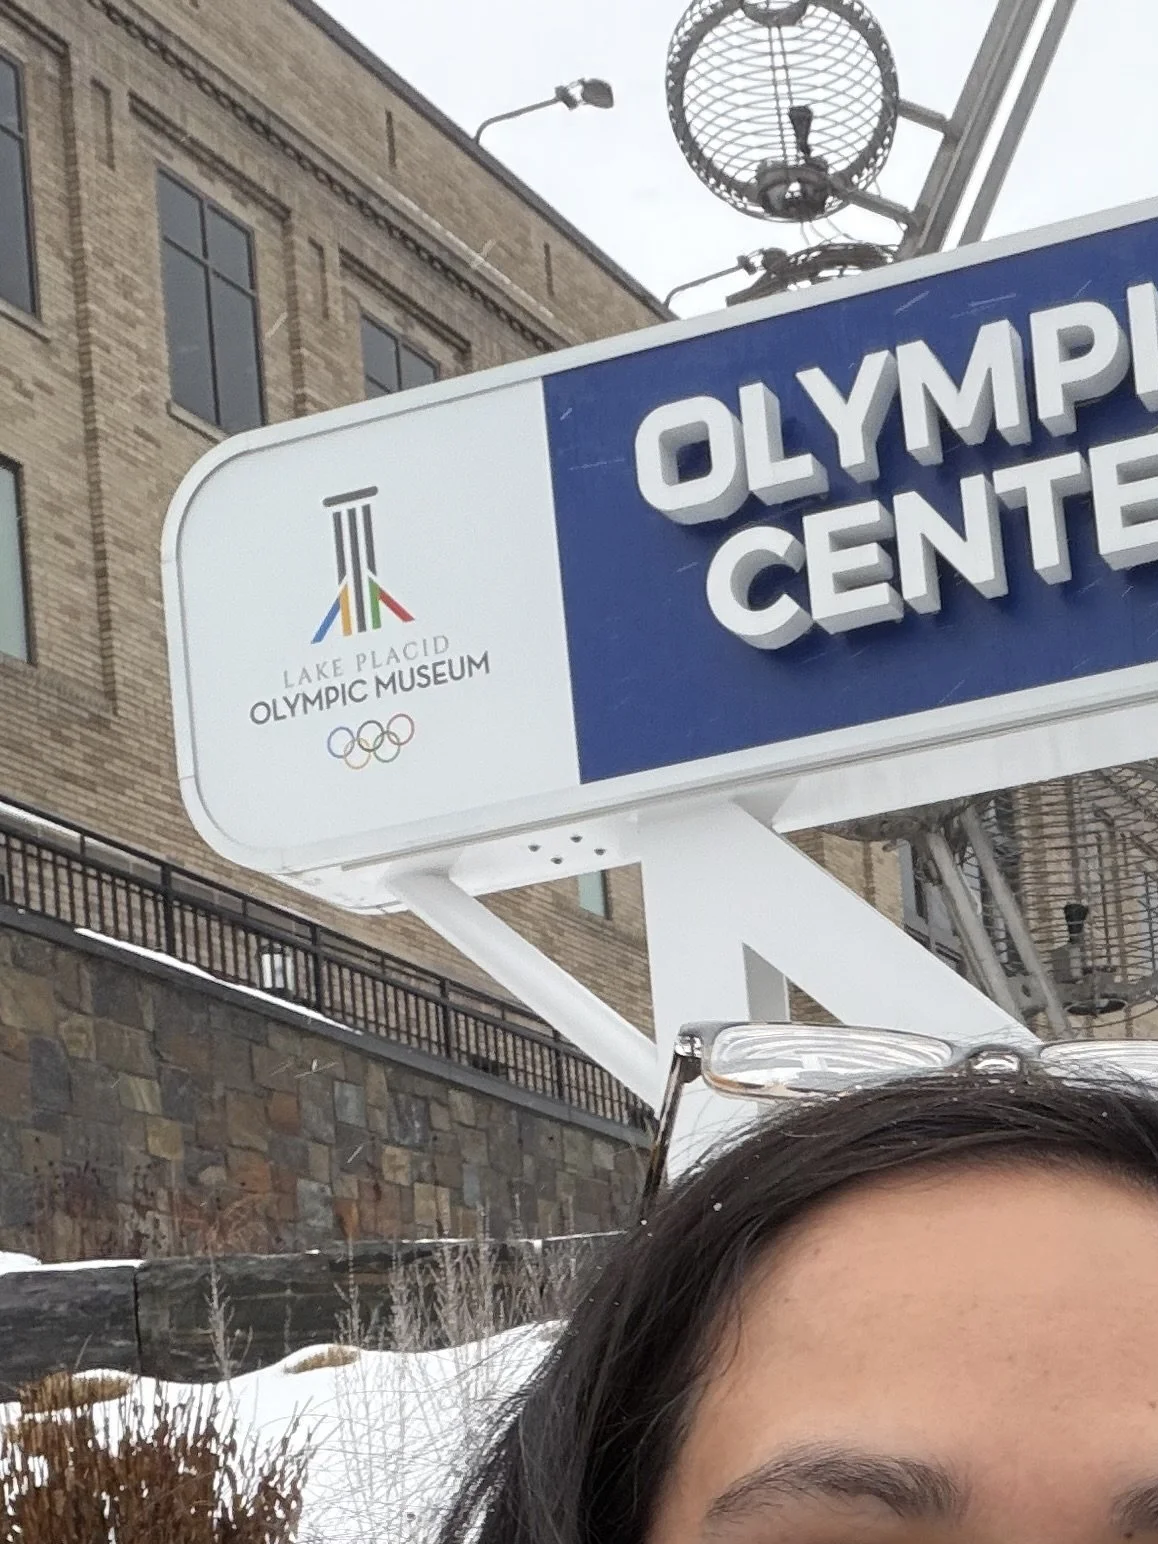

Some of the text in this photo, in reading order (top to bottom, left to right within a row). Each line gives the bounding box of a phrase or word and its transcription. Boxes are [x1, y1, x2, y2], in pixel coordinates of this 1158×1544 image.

[249, 651, 490, 725] OLYMPIC MUSEUM
[284, 635, 450, 689] LAKE PLACID
